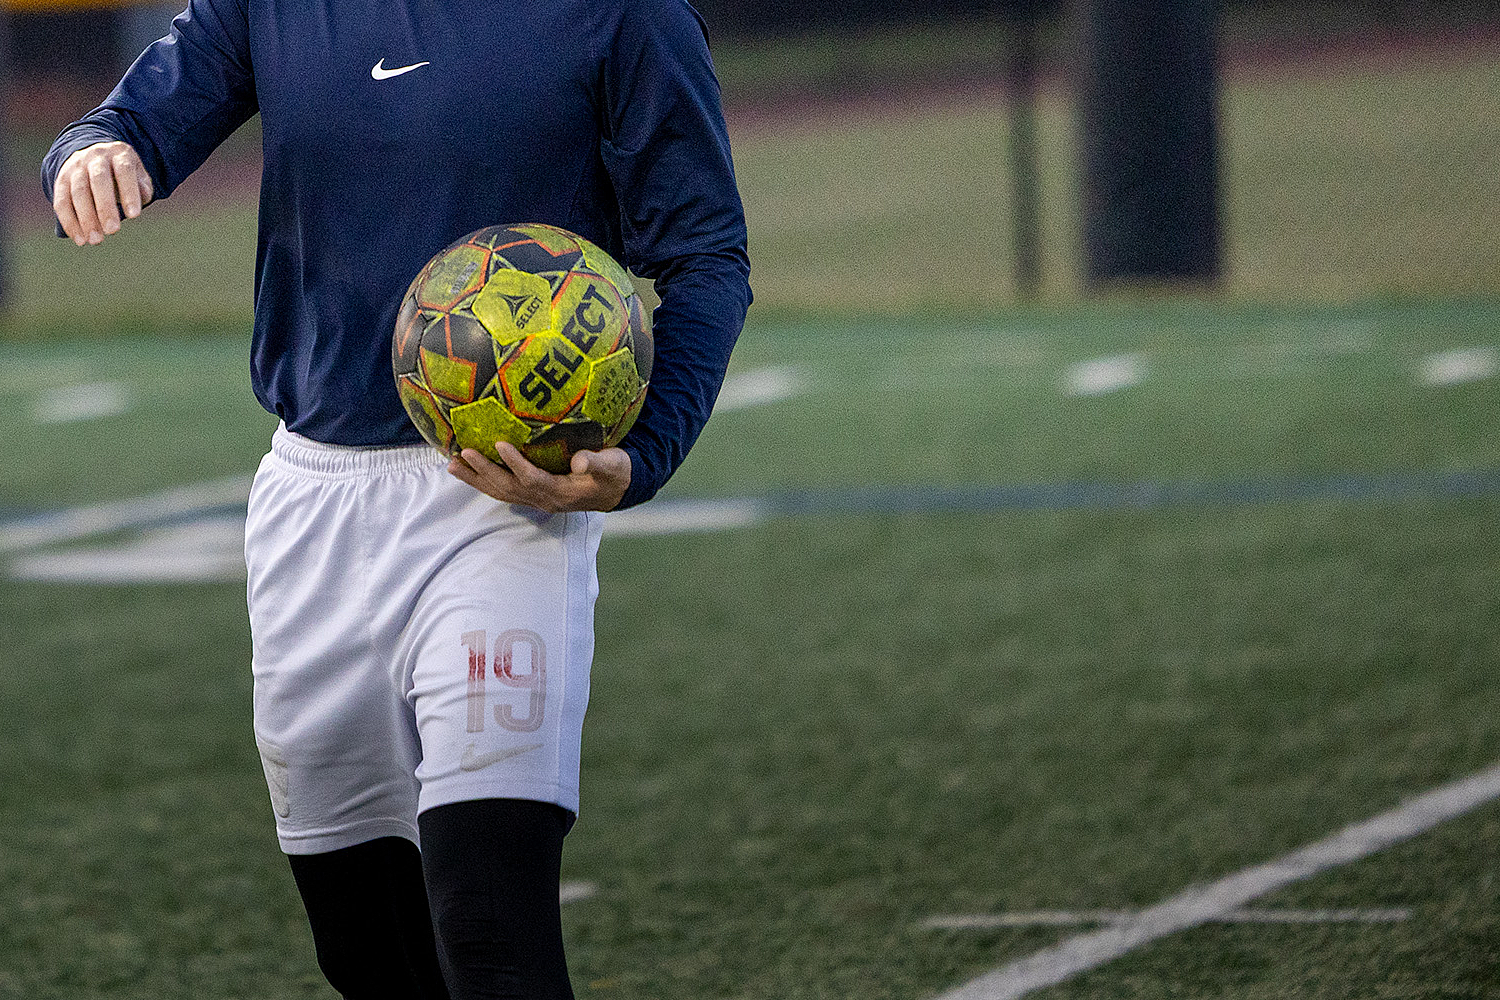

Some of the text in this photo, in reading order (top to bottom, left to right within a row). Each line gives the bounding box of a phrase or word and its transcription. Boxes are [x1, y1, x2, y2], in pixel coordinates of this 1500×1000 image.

[517, 297, 543, 330] SELECT
[519, 284, 614, 410] SELECT
[460, 629, 547, 733] 19
